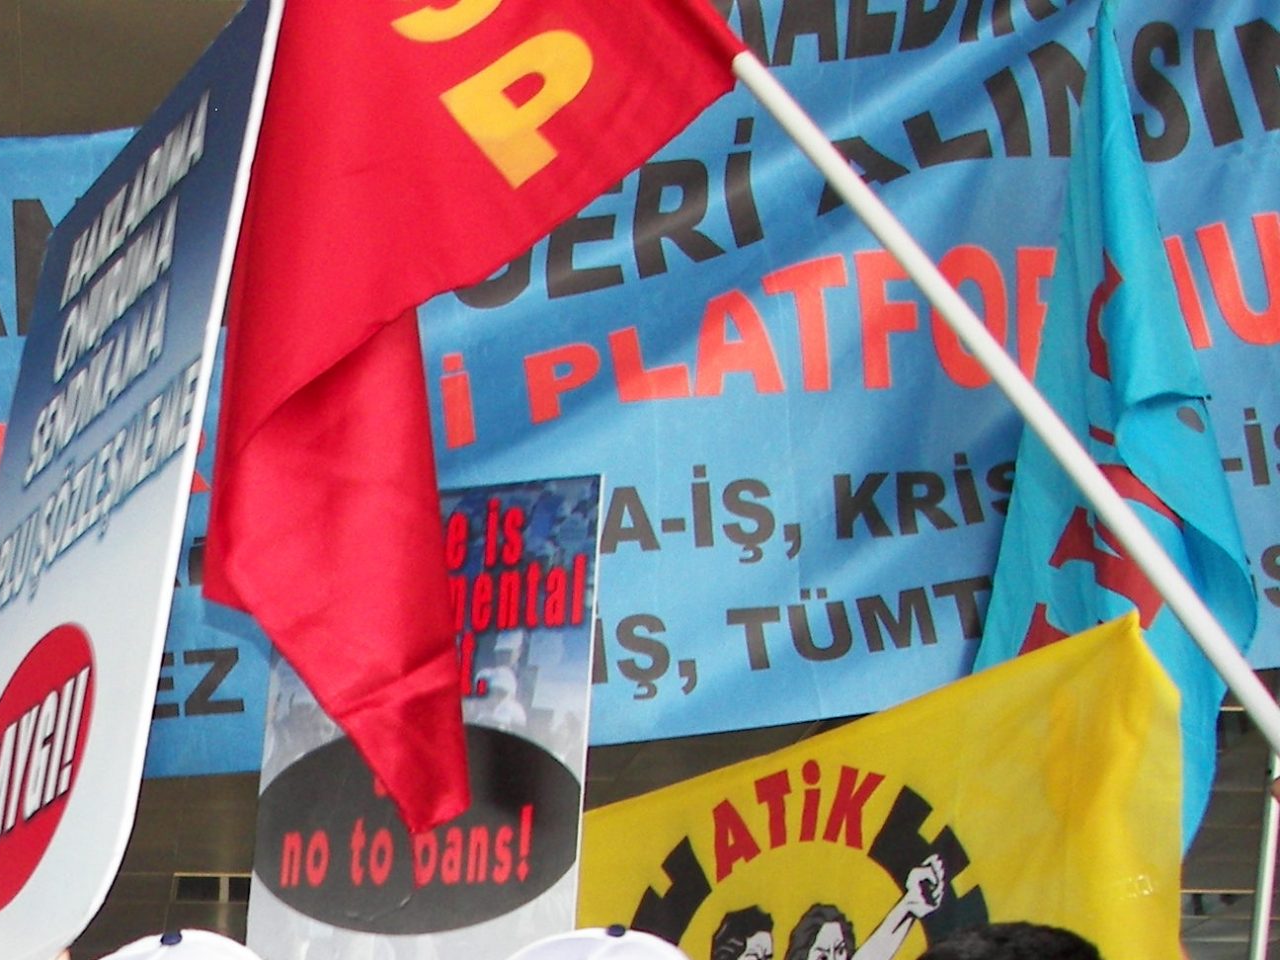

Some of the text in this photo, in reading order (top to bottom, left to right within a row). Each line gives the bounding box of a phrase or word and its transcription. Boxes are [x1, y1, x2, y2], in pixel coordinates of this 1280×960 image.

[453, 117, 766, 309] ERİ
[485, 498, 526, 567] is
[600, 464, 803, 566] A-İŞ,
[726, 575, 994, 672] TÜMT
[281, 828, 331, 888] no
[350, 818, 395, 887] to
